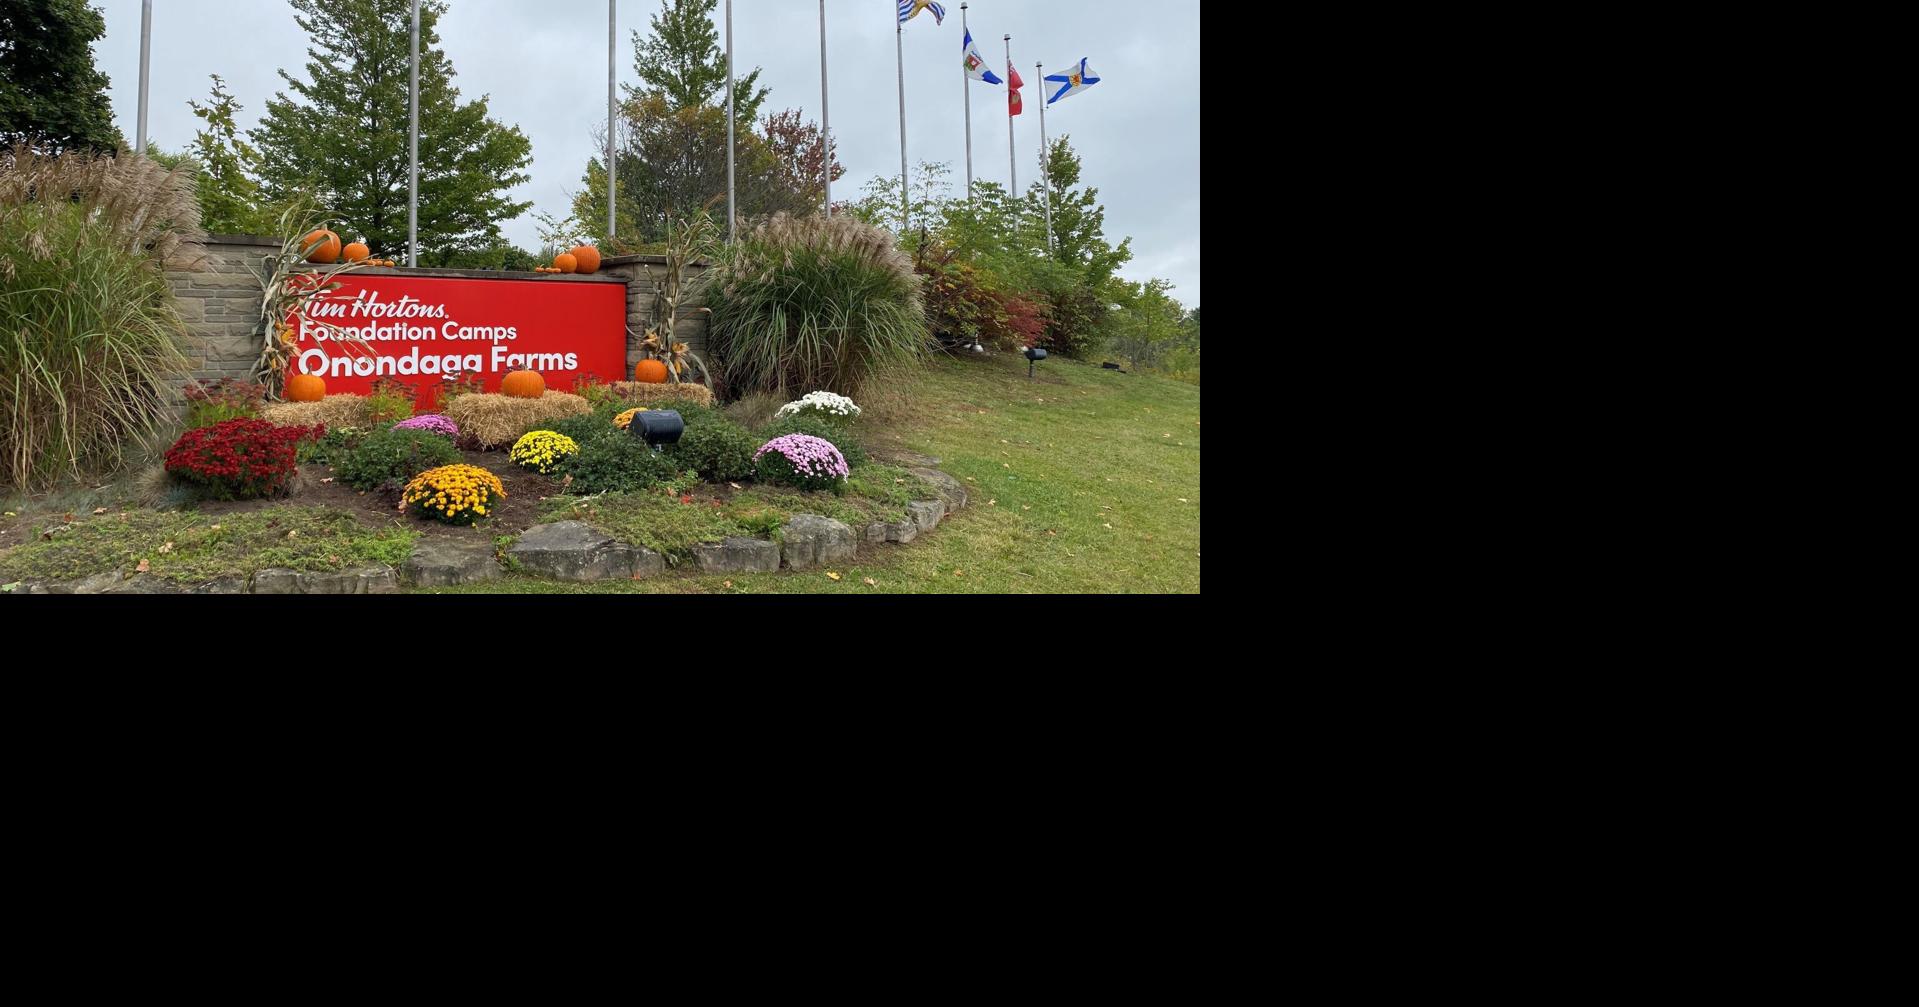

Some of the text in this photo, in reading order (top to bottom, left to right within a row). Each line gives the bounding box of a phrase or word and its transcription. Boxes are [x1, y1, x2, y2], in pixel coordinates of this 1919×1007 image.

[303, 289, 346, 317] Tim
[299, 320, 517, 345] Foundation Camps
[298, 346, 578, 380] Onondaga Farms
